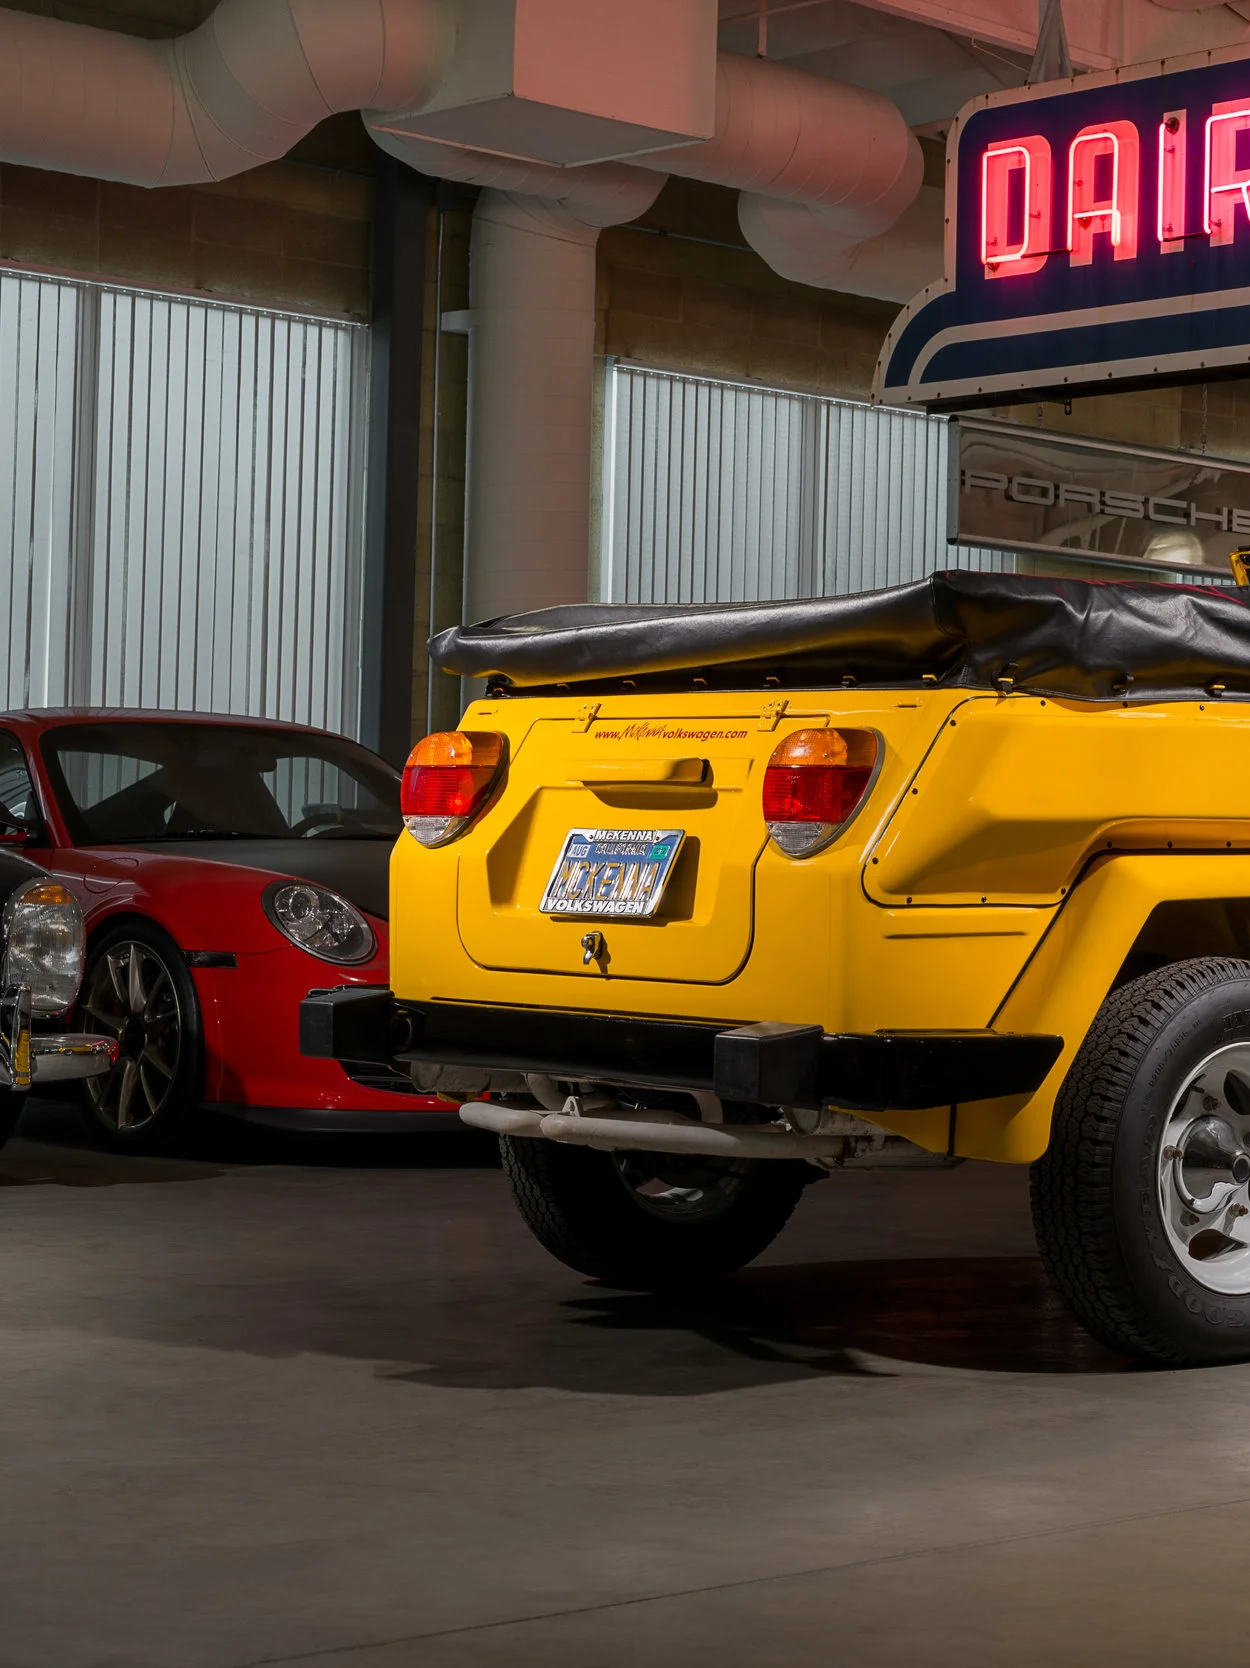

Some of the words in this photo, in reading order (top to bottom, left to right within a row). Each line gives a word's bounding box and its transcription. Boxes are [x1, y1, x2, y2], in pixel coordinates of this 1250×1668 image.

[571, 845, 588, 856] AUG
[595, 843, 648, 856] CALIFORNIA
[553, 861, 660, 900] MCKENNA
[547, 899, 645, 913] VOLKSWAGEN
